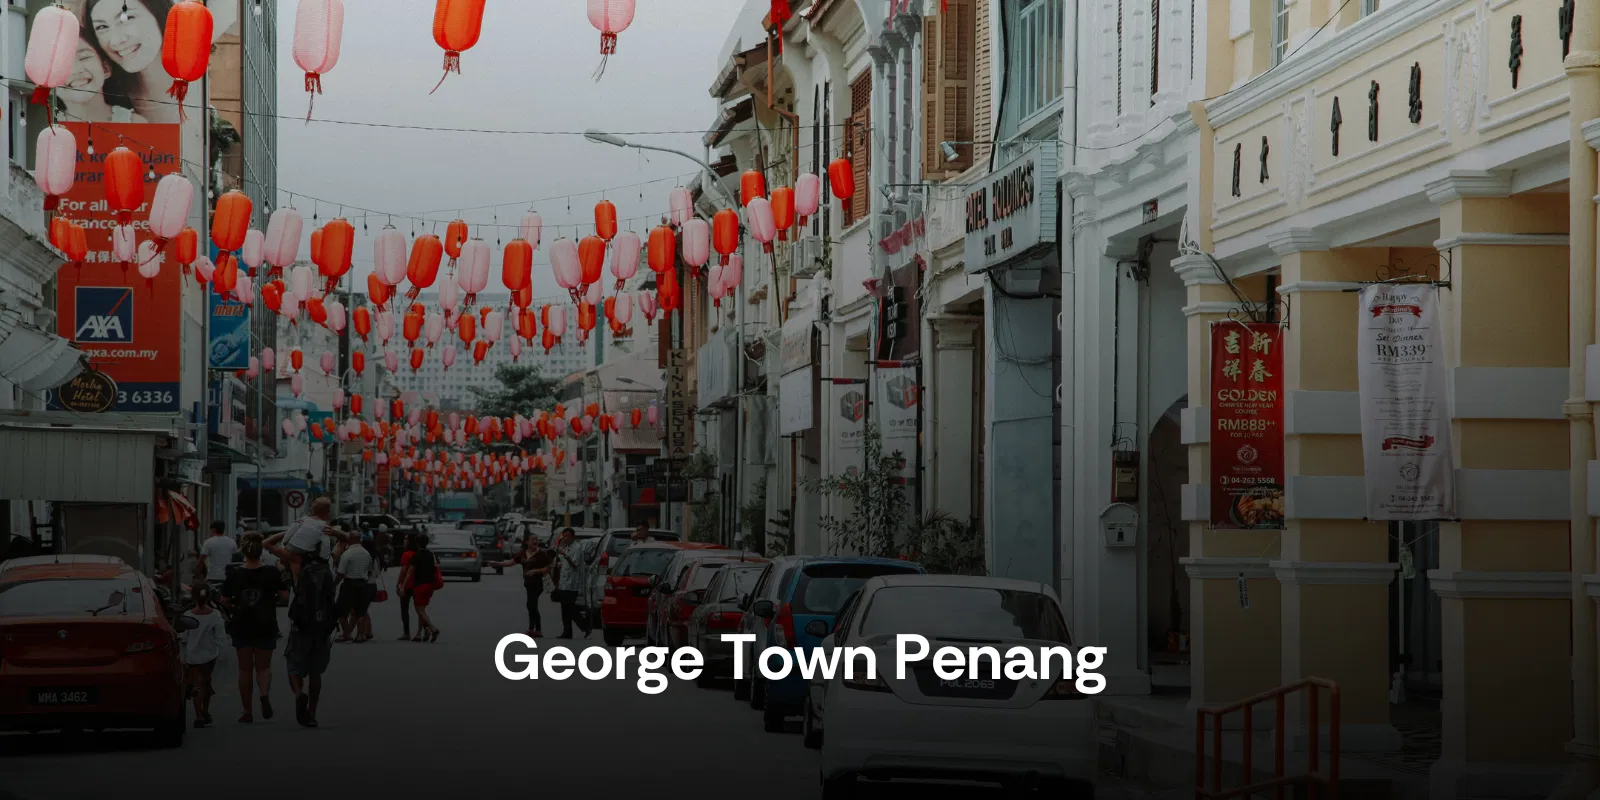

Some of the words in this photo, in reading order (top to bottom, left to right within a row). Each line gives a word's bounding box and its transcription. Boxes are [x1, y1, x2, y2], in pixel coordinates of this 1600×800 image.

[993, 160, 1034, 222] HOLDINGS
[60, 199, 87, 211] For
[90, 200, 107, 211] all
[1388, 315, 1404, 325] Day
[76, 315, 125, 339] AXA
[1376, 332, 1391, 341] Set
[1392, 333, 1424, 343] Dinner
[671, 351, 684, 398] KLINIK
[132, 391, 173, 404] 6336
[1217, 389, 1277, 402] GOLDEN
[38, 692, 58, 703] WMA
[60, 691, 88, 702] 3462
